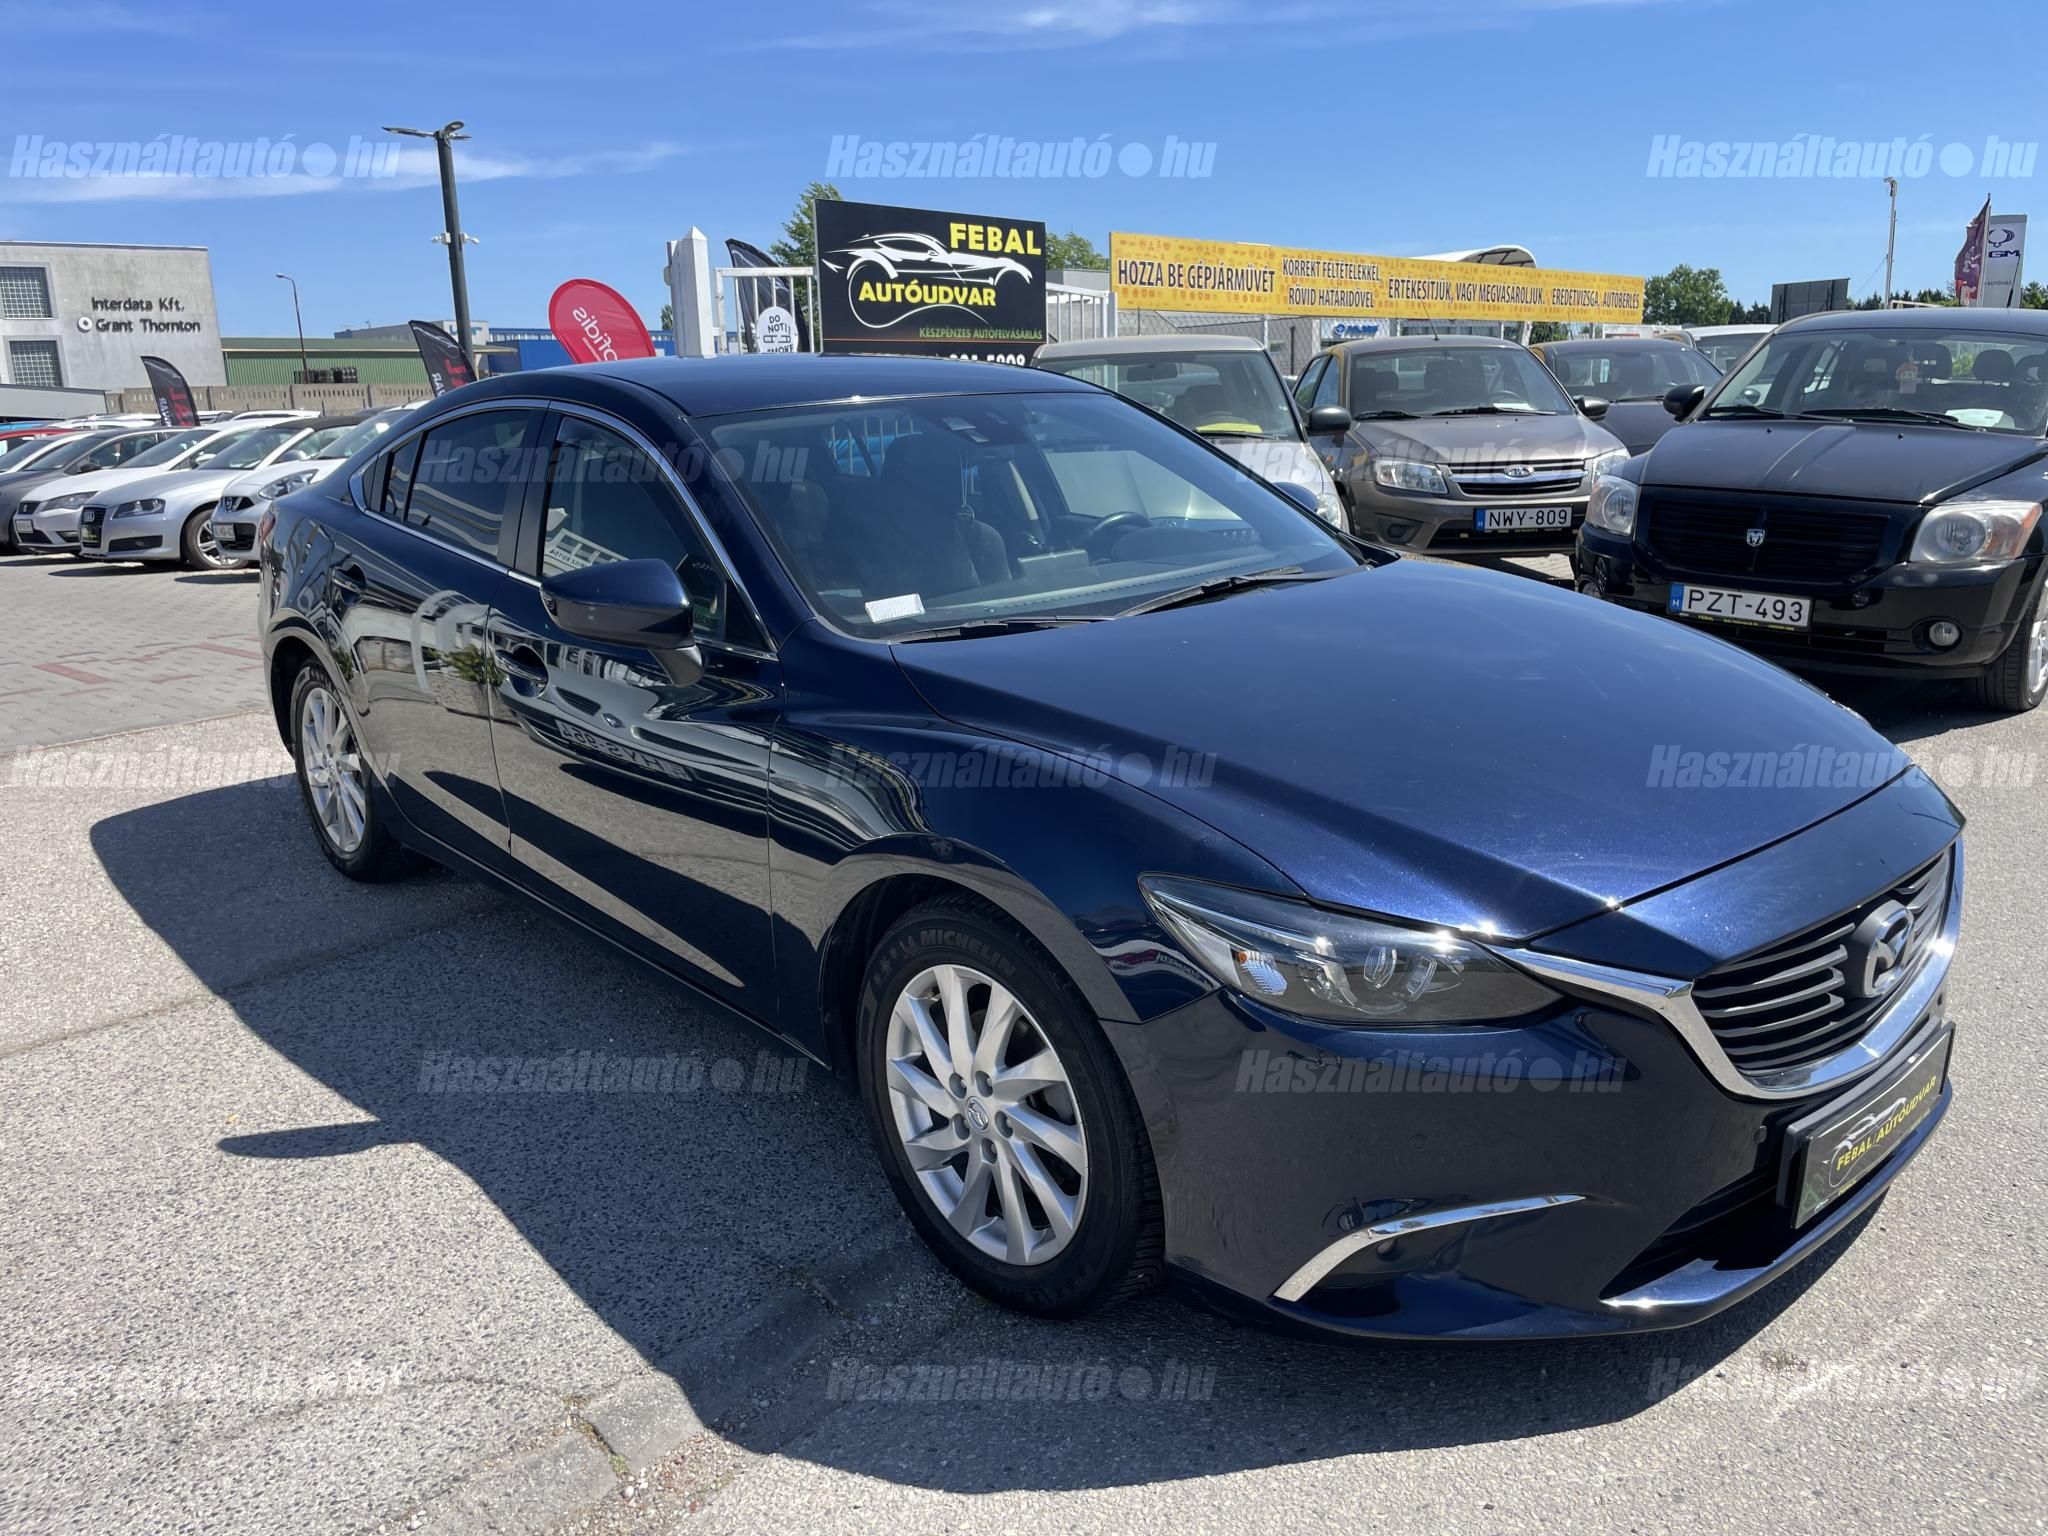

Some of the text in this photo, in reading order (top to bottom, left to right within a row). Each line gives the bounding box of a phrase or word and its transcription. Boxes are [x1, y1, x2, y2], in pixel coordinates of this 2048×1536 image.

[950, 223, 1041, 255] FEBAL
[1118, 260, 1164, 287] HOZZA
[1168, 263, 1184, 287] BE
[1283, 259, 1320, 277] KORREKT
[858, 279, 996, 306] AUTÓUDVAR
[1289, 284, 1316, 305] RÖVID
[1456, 282, 1480, 302] VAGY
[92, 297, 153, 311] Interdata
[96, 318, 200, 332] Grant Thornton
[768, 323, 784, 333] NOT
[769, 315, 780, 323] DO
[919, 326, 971, 338] KÉSZPÉNZES
[1489, 509, 1567, 527] NWY-809
[1688, 589, 1803, 622] PZT-493
[1836, 1138, 1873, 1171] FEBAL
